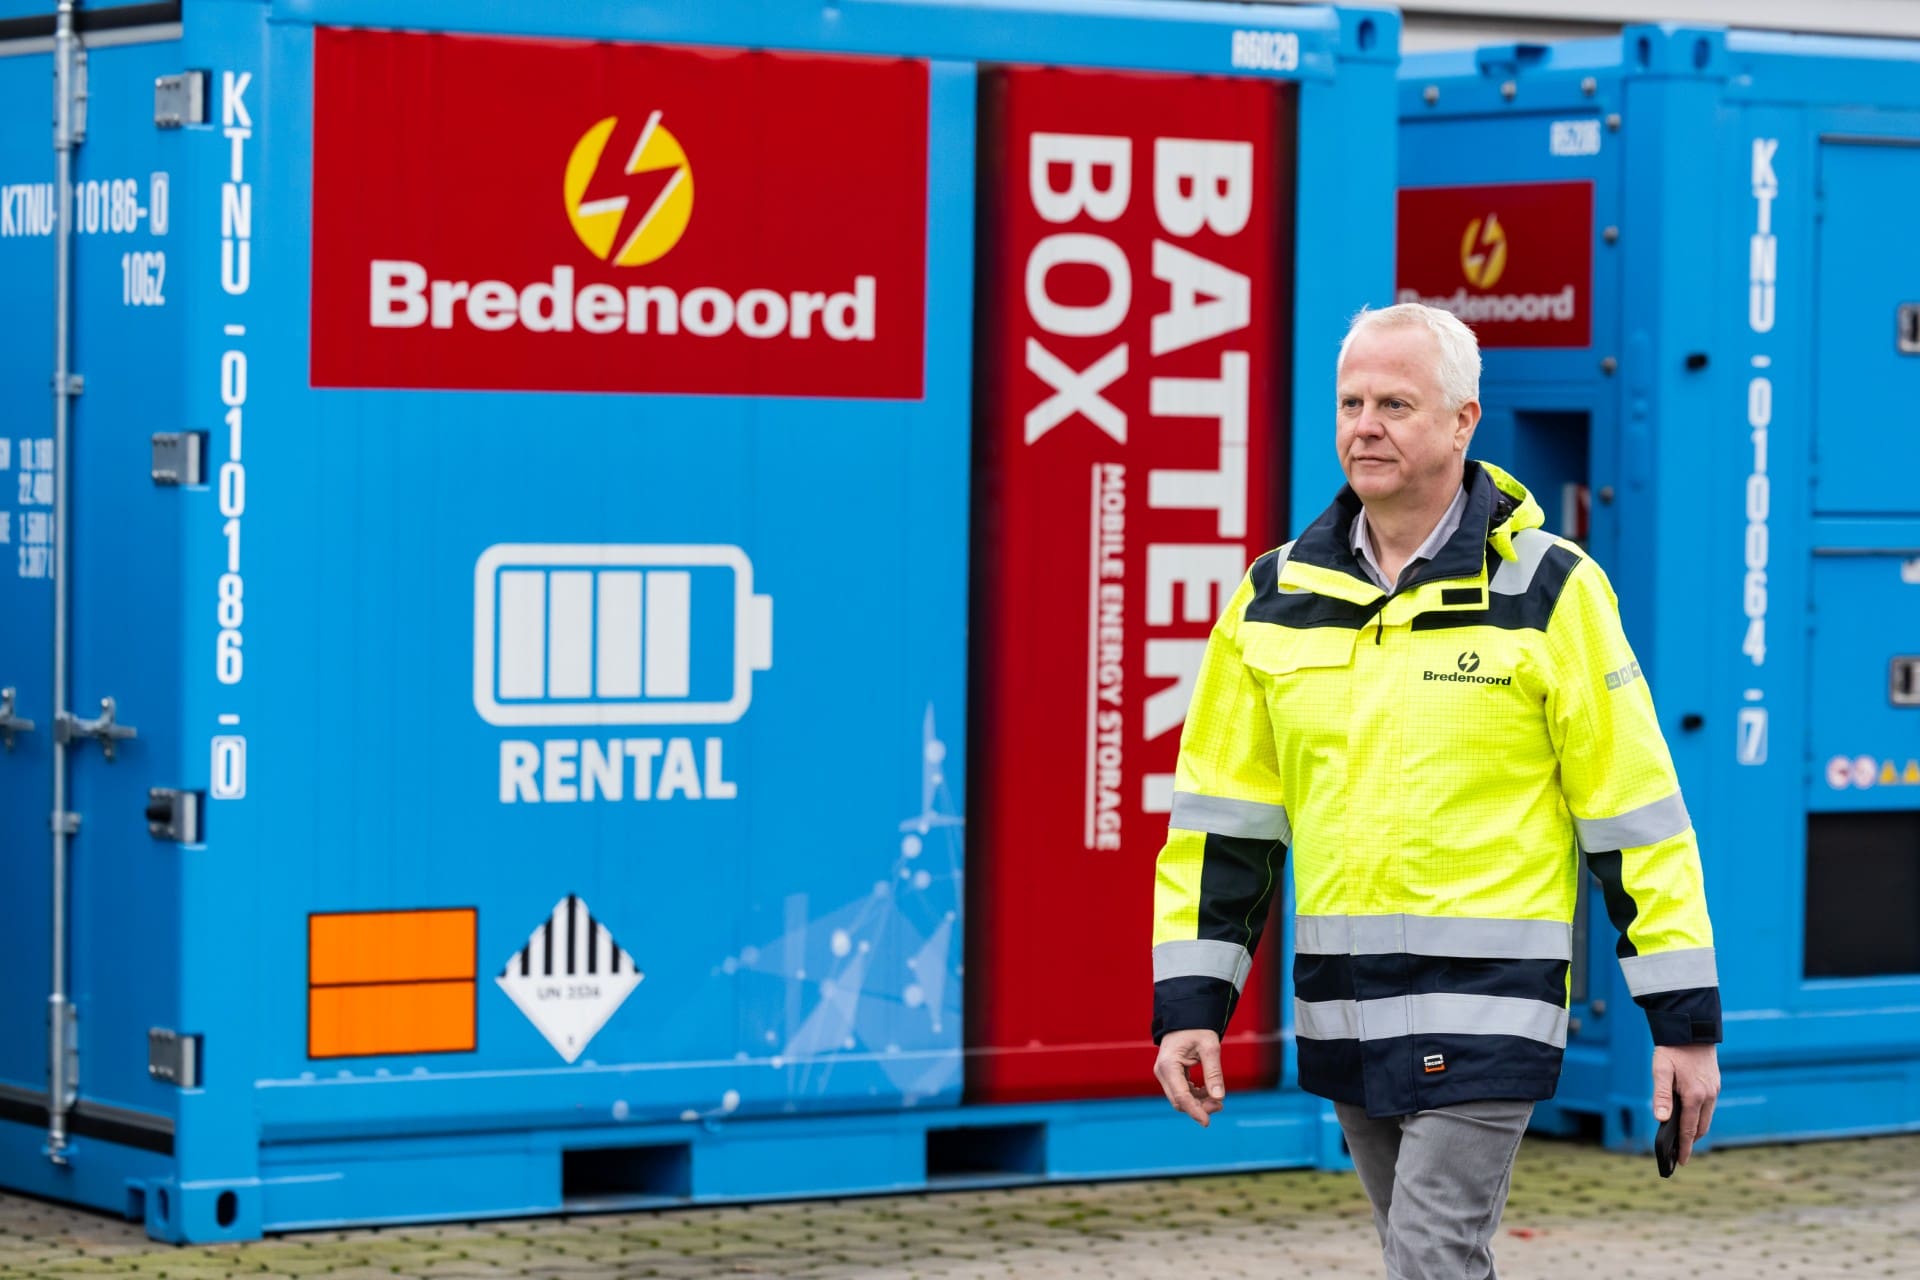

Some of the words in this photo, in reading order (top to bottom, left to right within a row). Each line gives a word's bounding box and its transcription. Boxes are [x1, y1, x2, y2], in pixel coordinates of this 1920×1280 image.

[1, 176, 168, 237] KTNU-10186-0
[369, 259, 877, 341] Bredenoord
[1024, 132, 1132, 446] BOX
[1397, 284, 1576, 322] Bdenoord
[1102, 463, 1126, 579] MOBILE
[1142, 136, 1253, 814] BATTER
[1099, 583, 1125, 706] ENERGY
[1423, 670, 1512, 686] Bredenoord
[500, 737, 738, 803] RENTAL
[1096, 709, 1124, 851] STORAGE
